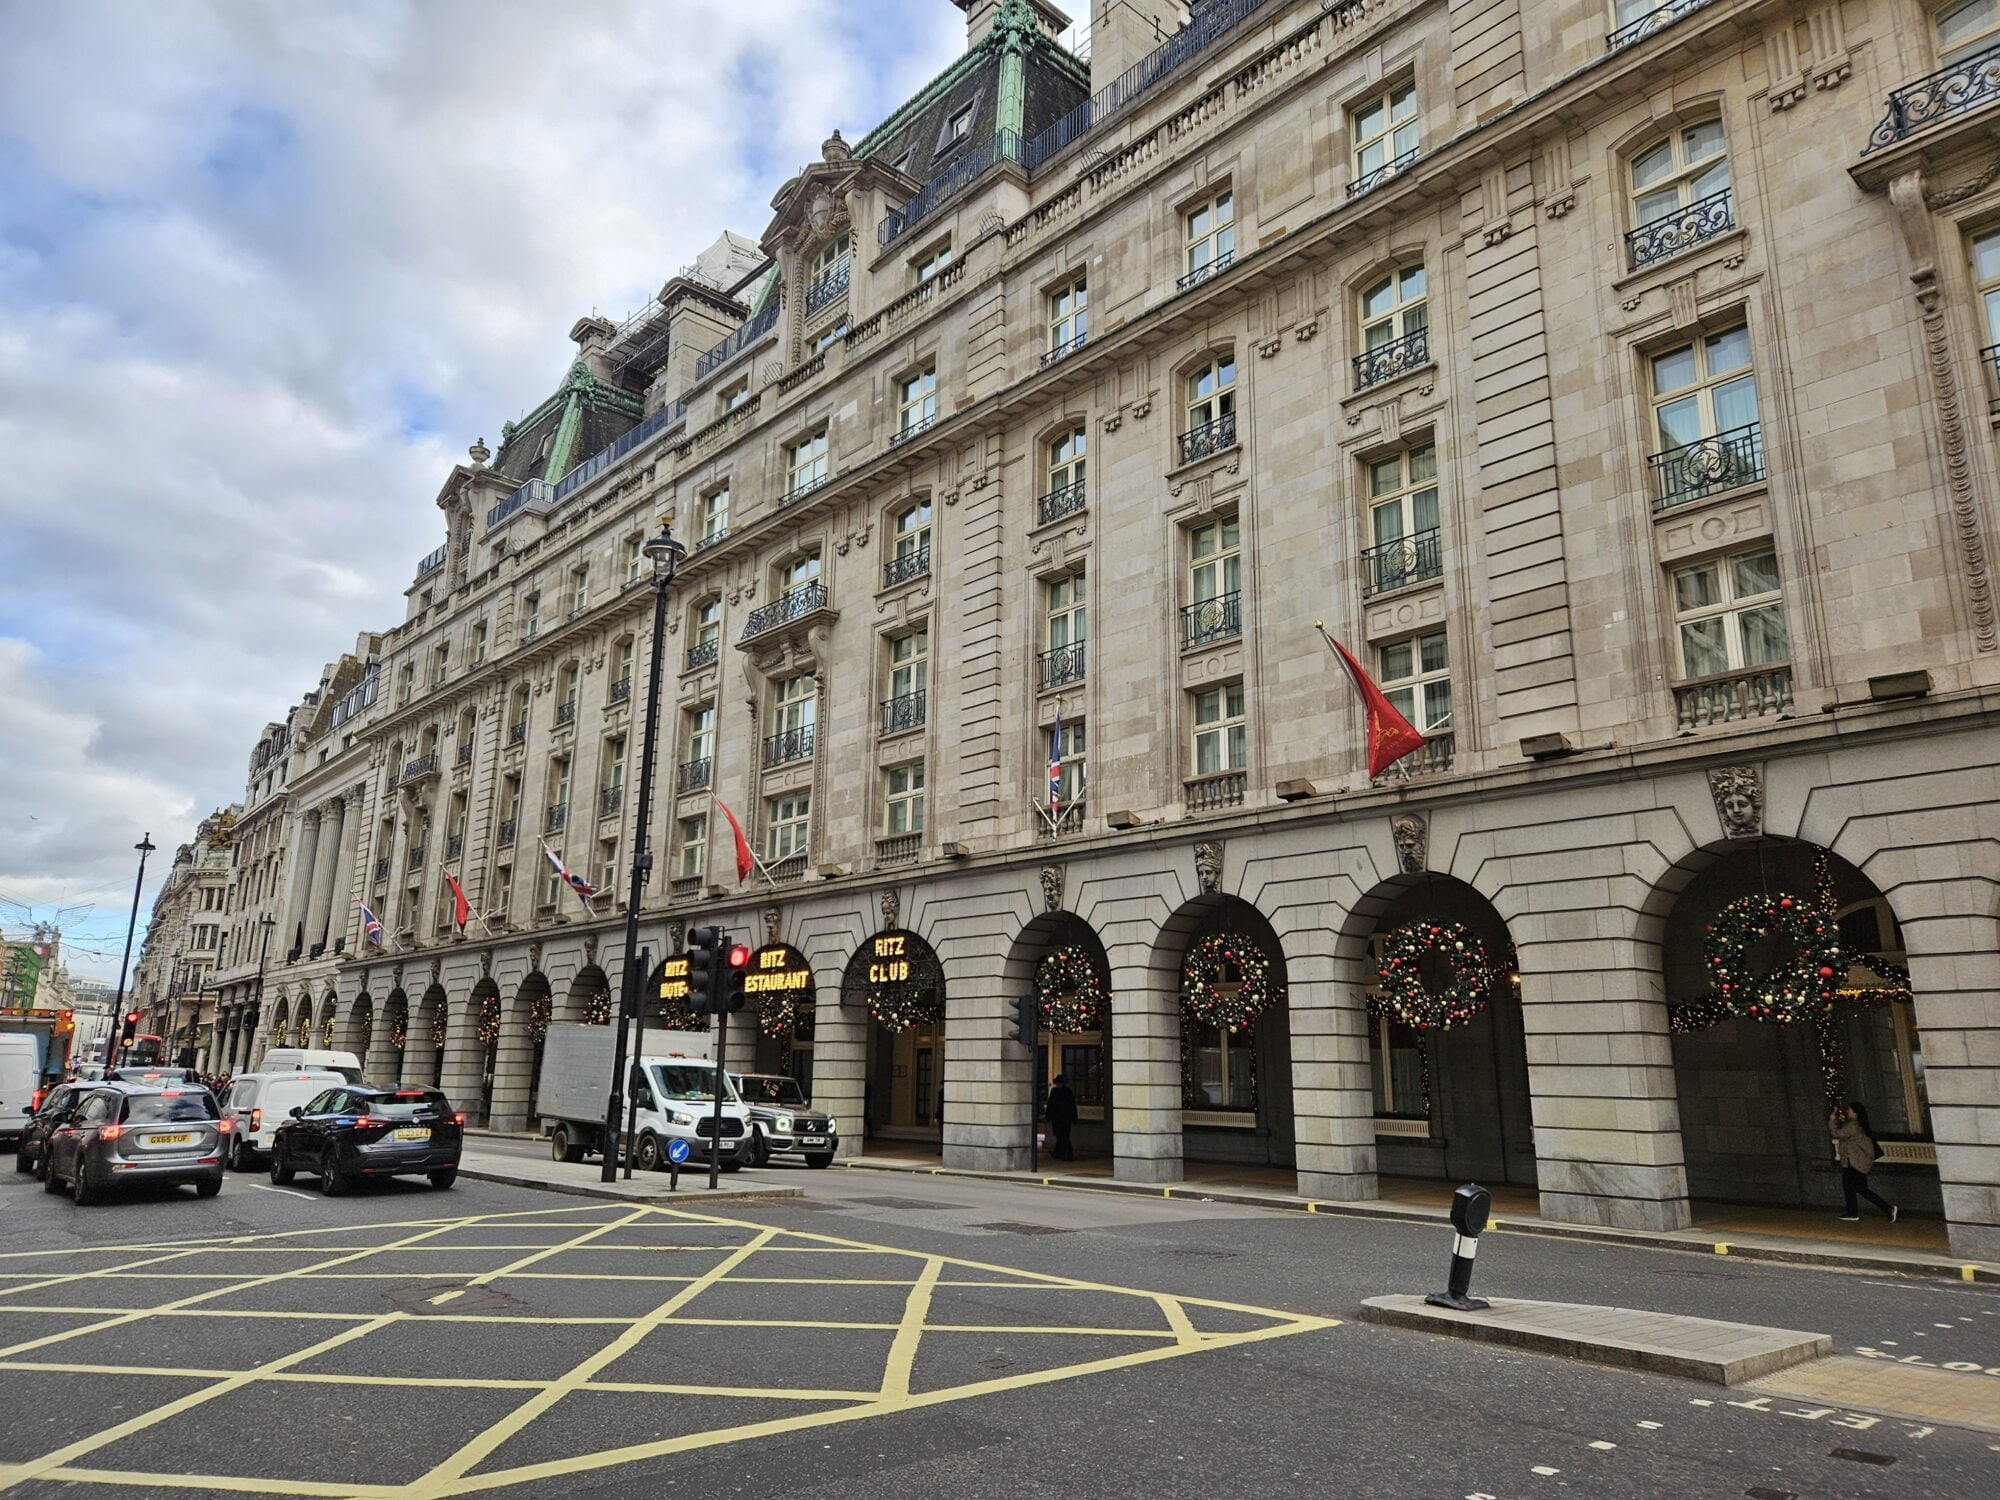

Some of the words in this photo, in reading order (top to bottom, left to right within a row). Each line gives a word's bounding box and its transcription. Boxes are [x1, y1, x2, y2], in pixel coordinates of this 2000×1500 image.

[874, 936, 905, 957] RITZ
[664, 959, 688, 977] RITZ
[760, 949, 786, 969] RITZ
[744, 971, 810, 993] ESTAURANT
[869, 961, 909, 983] CLUB
[659, 981, 689, 999] HOTE
[1726, 1398, 1937, 1439] LEFT
